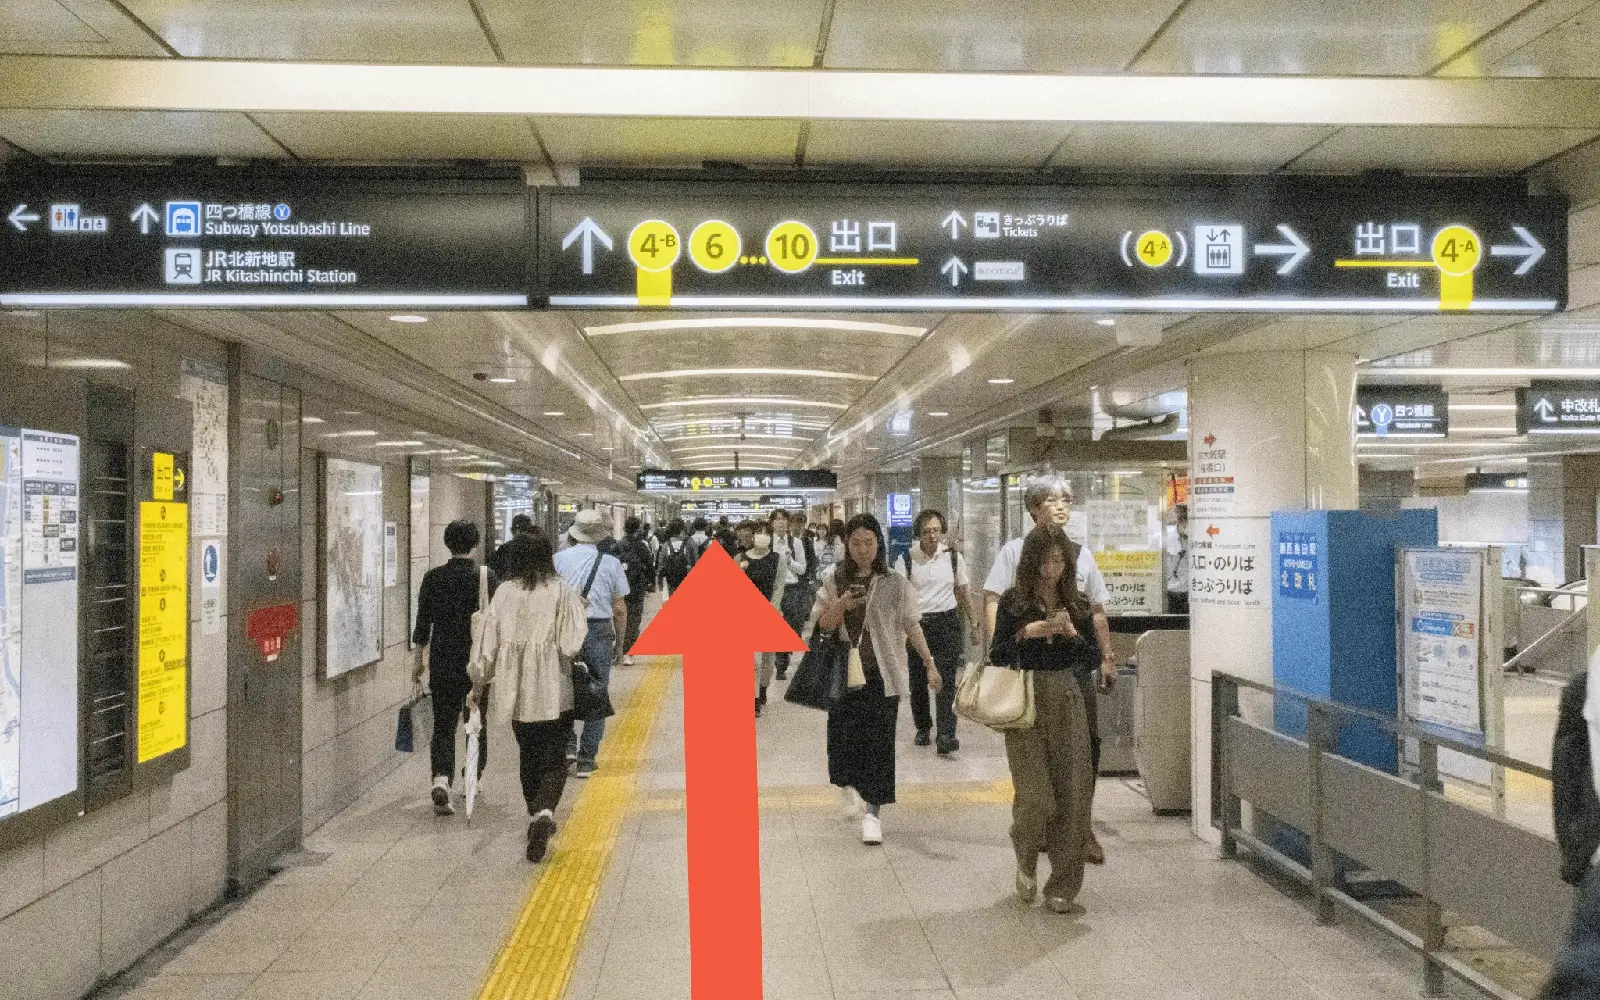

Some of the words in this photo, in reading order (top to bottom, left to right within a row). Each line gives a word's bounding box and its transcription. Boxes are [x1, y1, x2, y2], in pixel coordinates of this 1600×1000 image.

[206, 204, 271, 220] 四つ橋線
[1002, 214, 1069, 226] きっぷうりば
[205, 222, 259, 237] Subway
[262, 222, 336, 236] Yotsubashi
[339, 222, 371, 236] Line
[1002, 227, 1038, 238] Tickets
[706, 234, 724, 260] 6
[775, 233, 810, 260] 10
[830, 219, 897, 253] 出口
[1354, 222, 1420, 254] 出口
[205, 251, 295, 267] JR北新地駅
[204, 269, 222, 282] JR
[226, 269, 303, 282] Kitashinchi
[307, 269, 356, 282] Station
[831, 269, 865, 285] Exit
[1386, 272, 1420, 288] Exit
